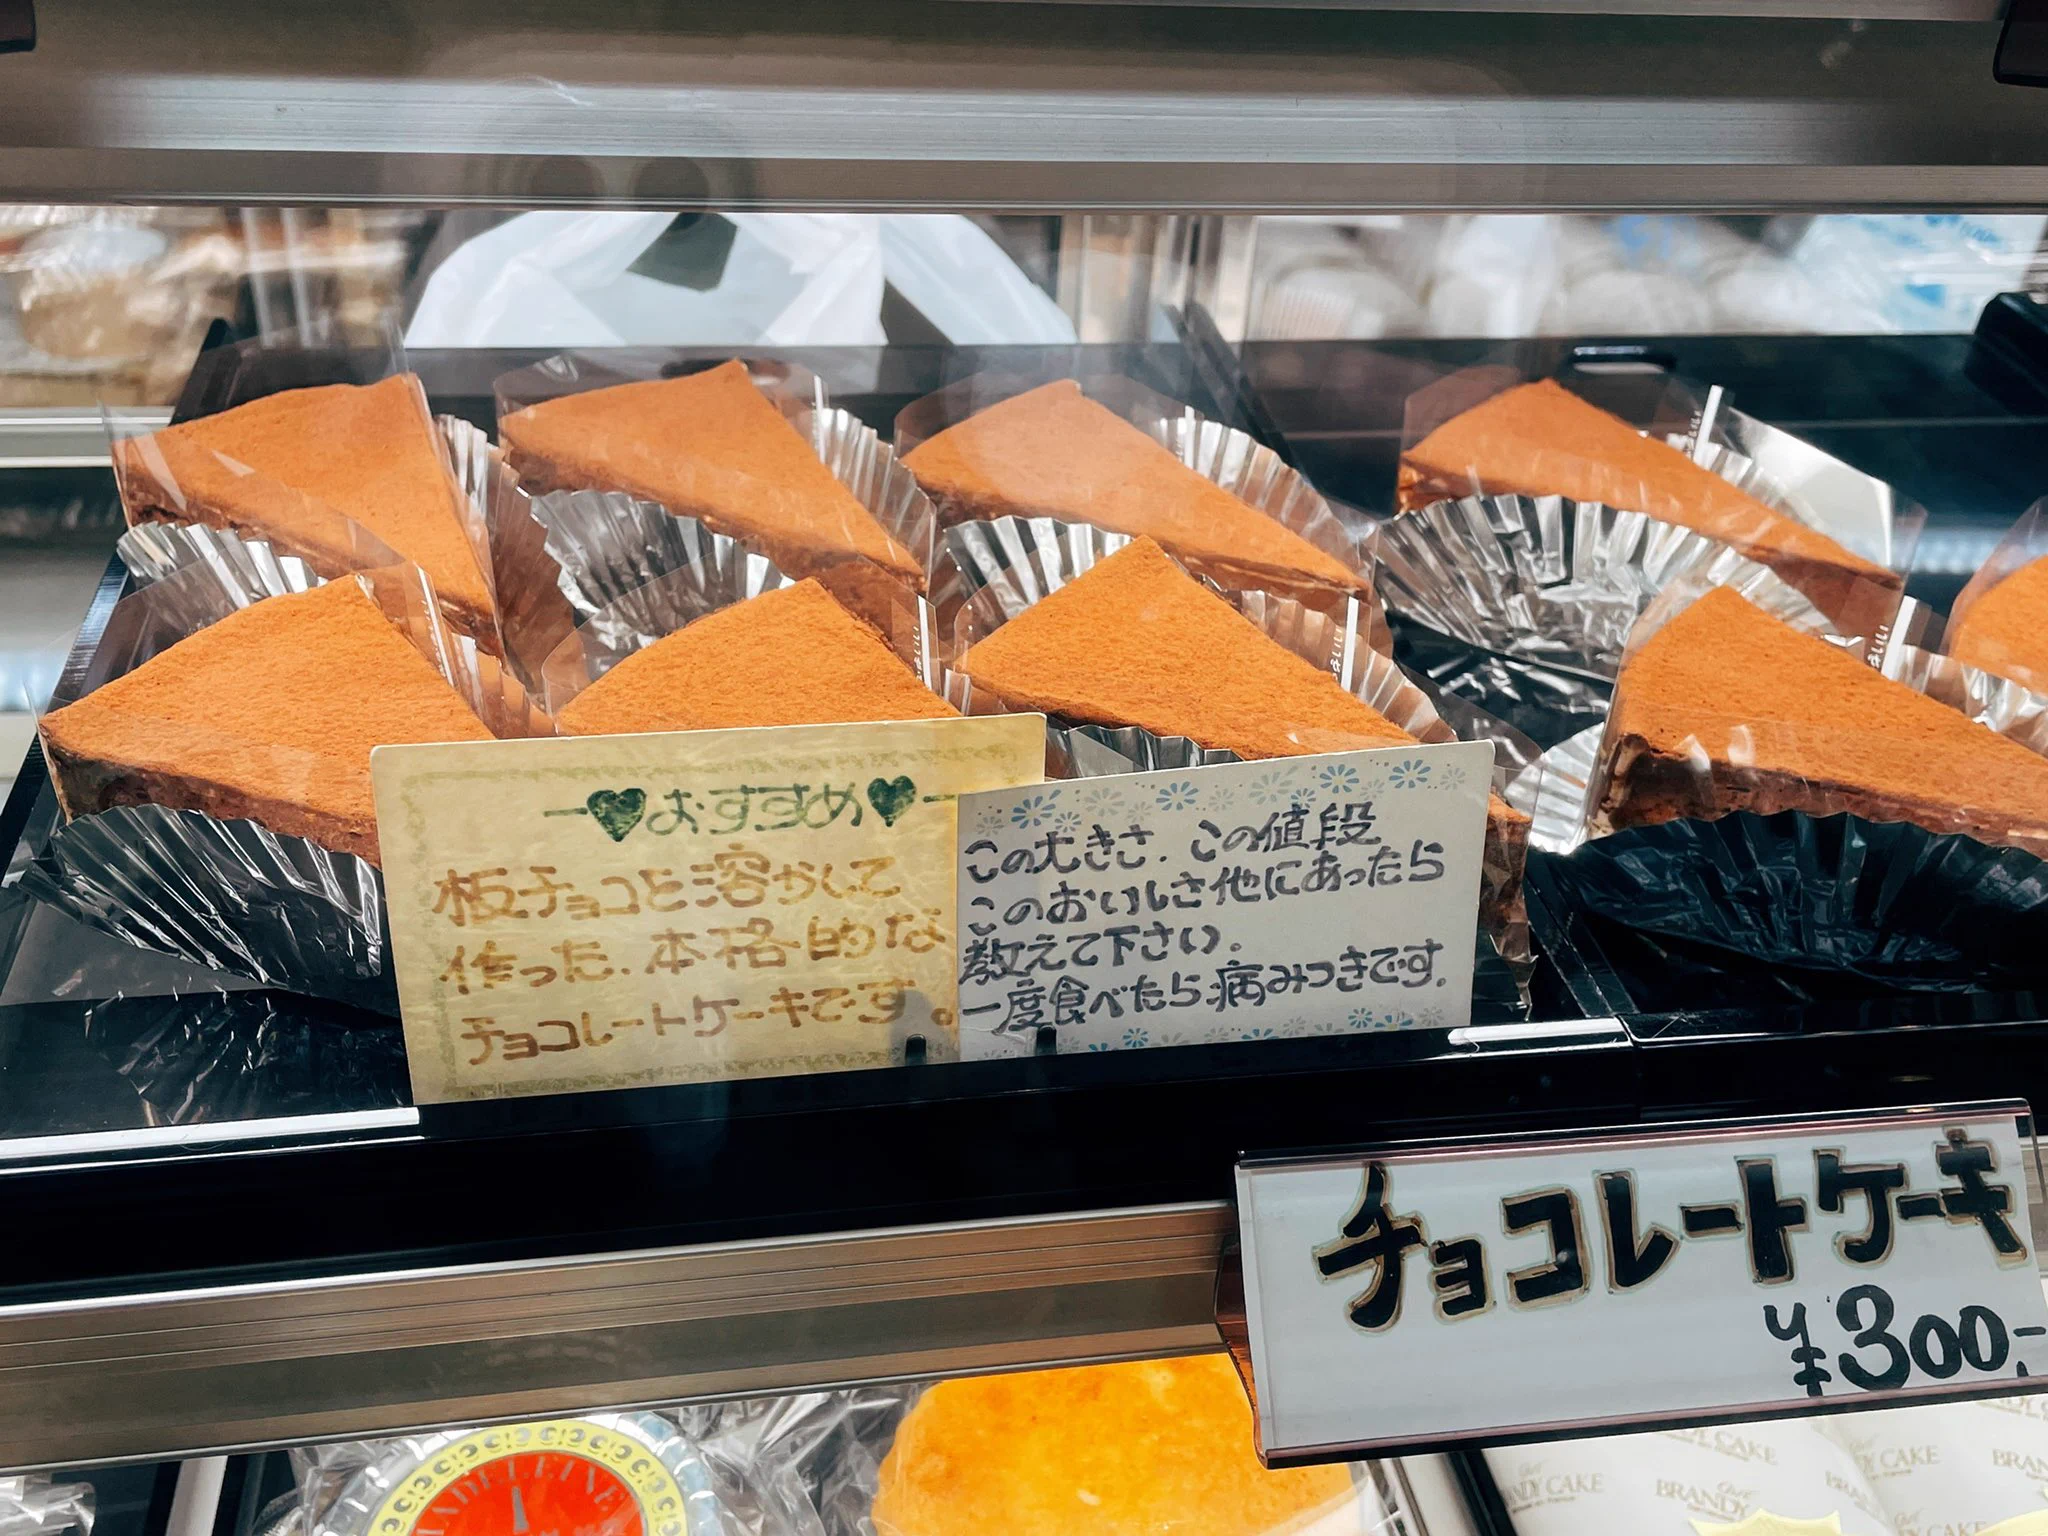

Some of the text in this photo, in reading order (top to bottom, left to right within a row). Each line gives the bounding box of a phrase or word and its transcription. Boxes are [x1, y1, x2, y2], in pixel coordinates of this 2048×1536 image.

[646, 781, 864, 836] おすすめ
[967, 840, 1445, 937] このおいしさ他にあったら
[1312, 1127, 2029, 1333] チョコレートケーキ
